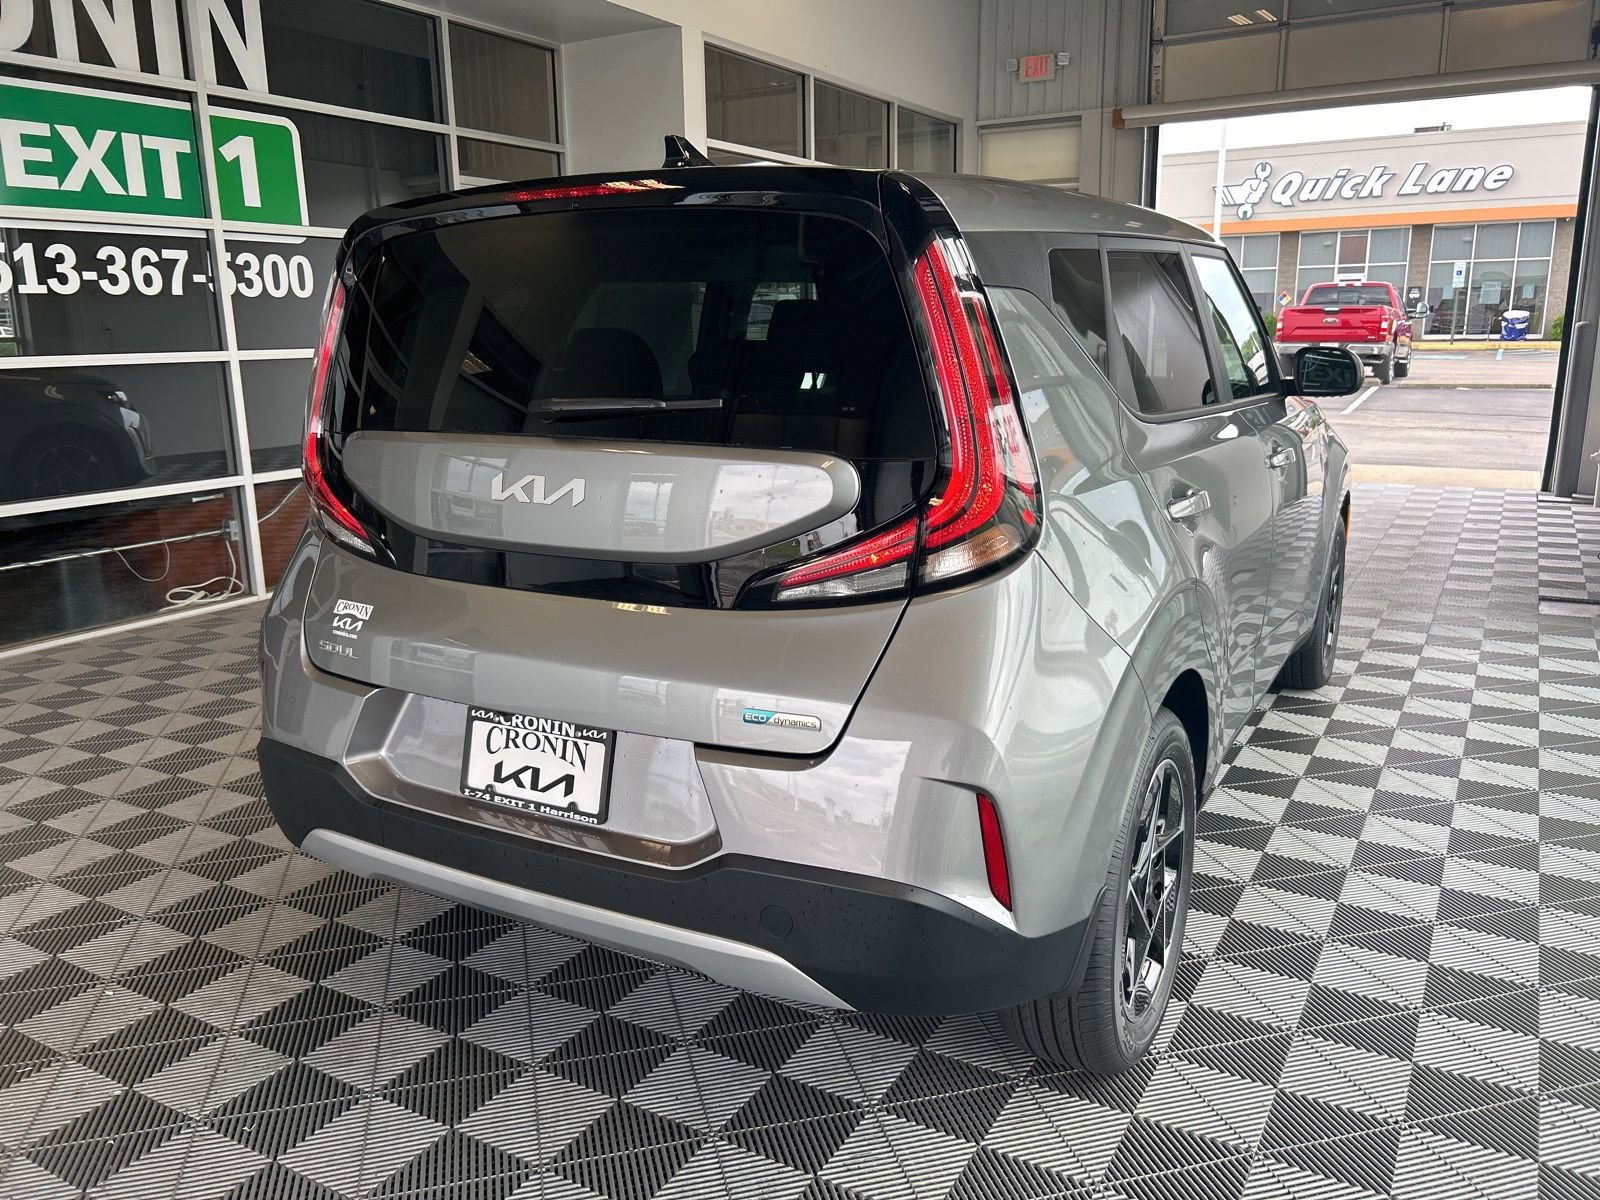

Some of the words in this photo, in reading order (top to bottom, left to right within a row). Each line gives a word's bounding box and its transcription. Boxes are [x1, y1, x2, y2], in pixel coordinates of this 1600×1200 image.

[1024, 55, 1050, 78] EXIT
[0, 118, 191, 199] EXIT
[218, 135, 262, 208] 1
[1271, 164, 1396, 207] Quick
[1398, 162, 1515, 197] Lane
[492, 472, 586, 507] KIA
[333, 616, 363, 632] KIA
[337, 602, 371, 619] CRONIN
[319, 640, 360, 659] SOUL
[471, 709, 494, 720] KIA
[582, 728, 607, 740] KIA
[744, 712, 767, 722] ECO
[773, 716, 817, 728] dynamics
[486, 725, 590, 773] CRONIN
[493, 760, 575, 798] KIA
[463, 788, 491, 801] I-74
[494, 795, 526, 808] EXIT
[528, 803, 537, 811] 1
[540, 805, 598, 825] Harrison
